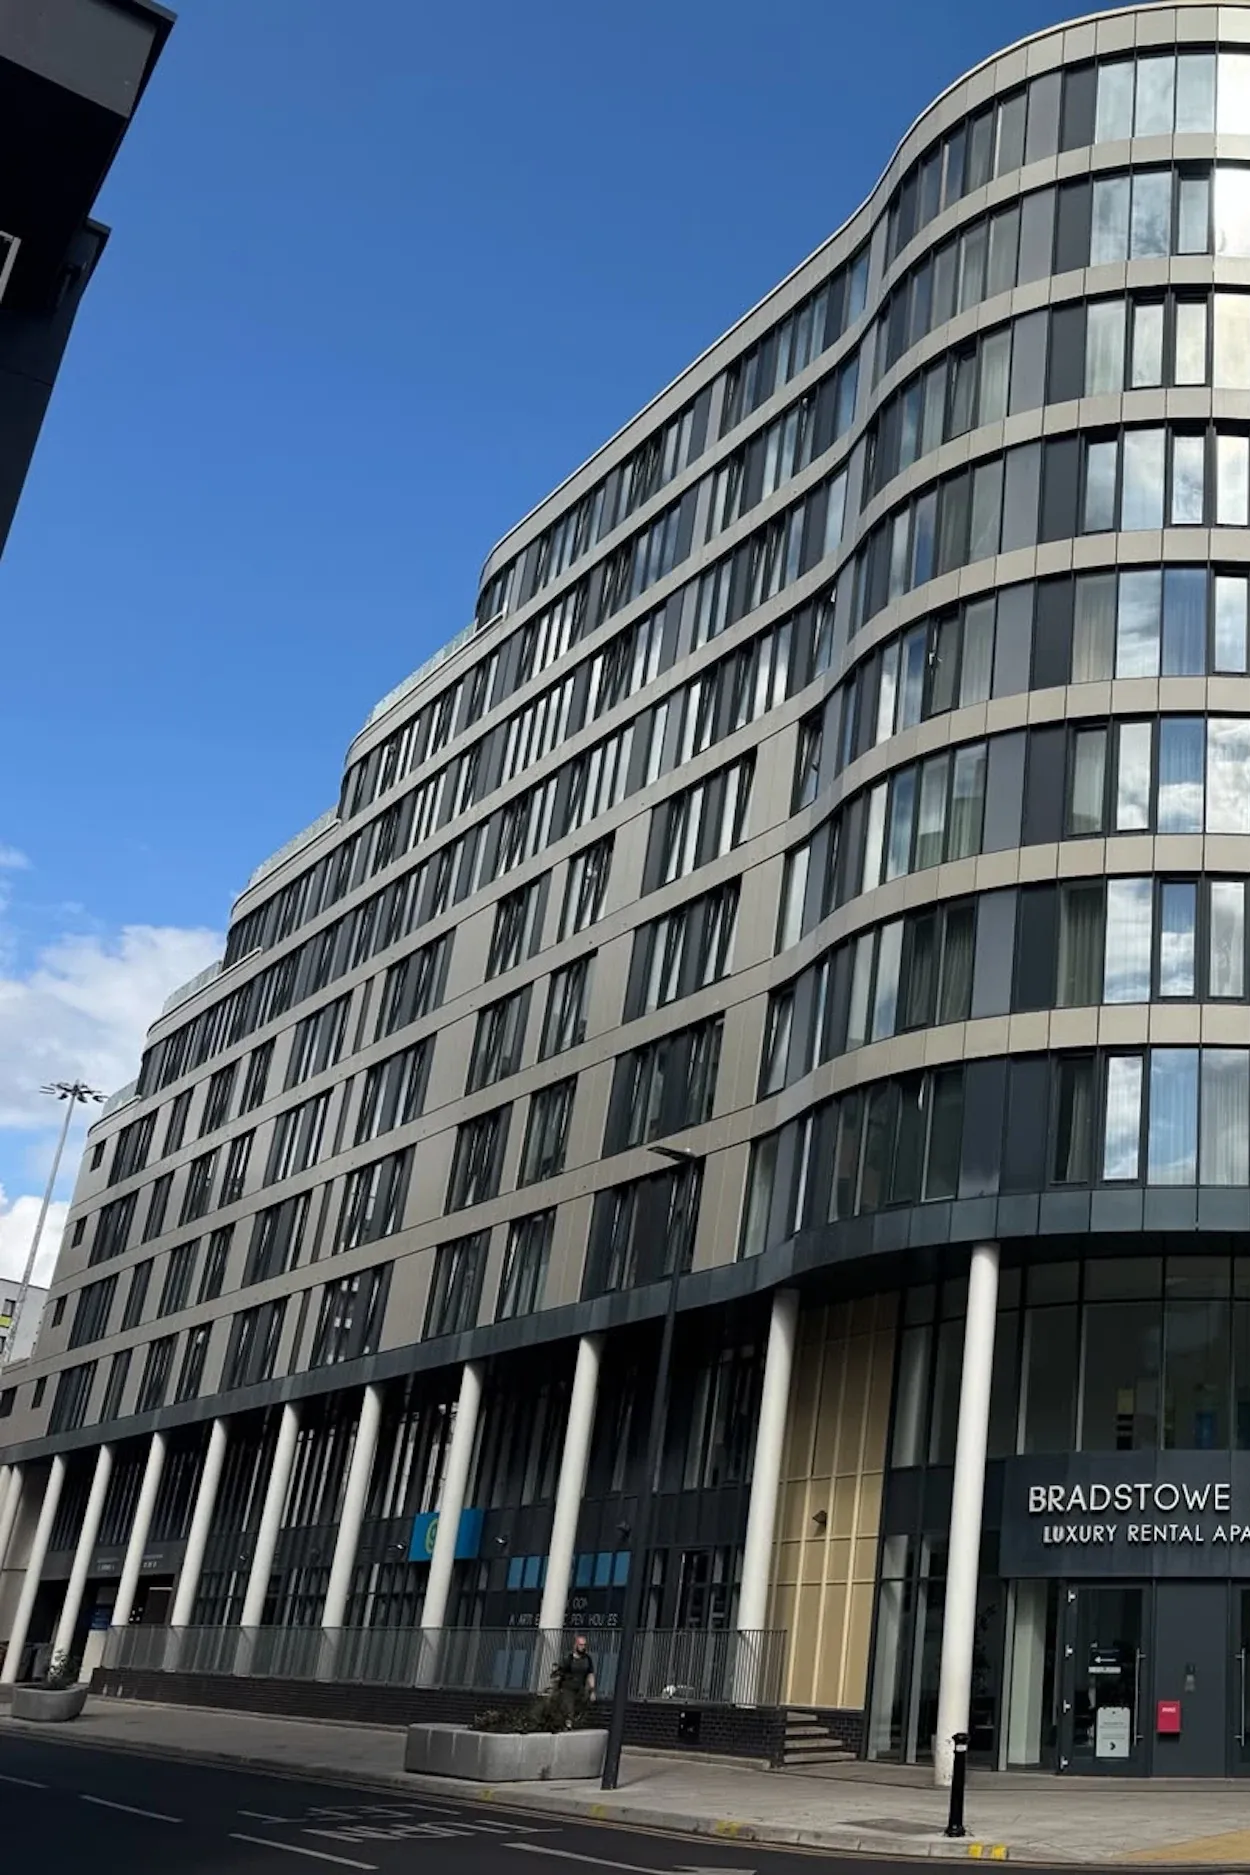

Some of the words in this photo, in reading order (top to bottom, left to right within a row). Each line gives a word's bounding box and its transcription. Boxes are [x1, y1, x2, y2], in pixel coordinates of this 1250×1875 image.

[1028, 1483, 1231, 1513] BRADSTOWE
[1042, 1524, 1118, 1544] LUXURY
[1127, 1524, 1204, 1542] RENTAL
